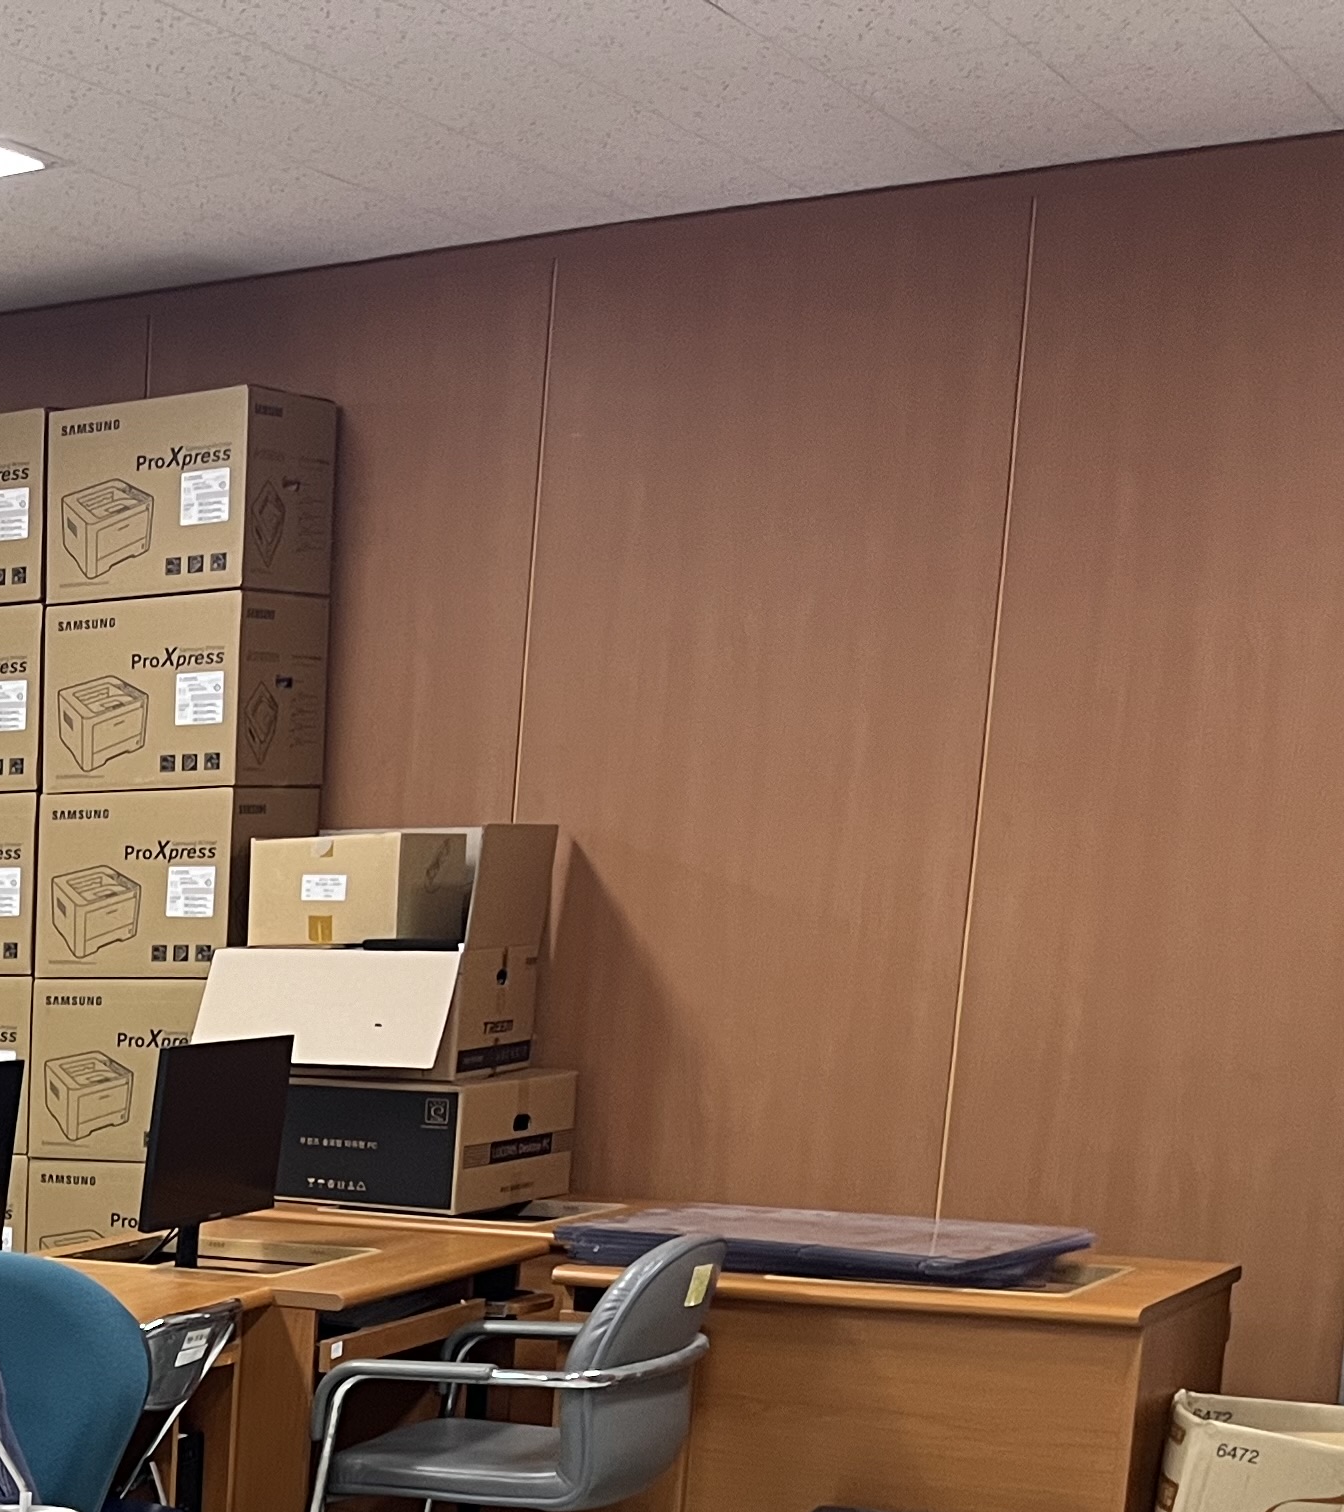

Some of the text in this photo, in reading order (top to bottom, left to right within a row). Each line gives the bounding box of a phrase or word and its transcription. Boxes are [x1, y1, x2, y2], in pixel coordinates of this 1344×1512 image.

[62, 419, 119, 436] SAMSUNG
[137, 446, 231, 471] ProXpress
[58, 618, 115, 631] SAMSUNG
[132, 647, 224, 670] ProXpress
[52, 809, 109, 820] SAMSUNG
[125, 840, 216, 863] ProXpress
[46, 996, 102, 1006] SAMSUNG
[117, 1029, 188, 1047] ProXpre
[41, 1174, 96, 1186] SAMSUNG
[1216, 1443, 1259, 1464] 6472
